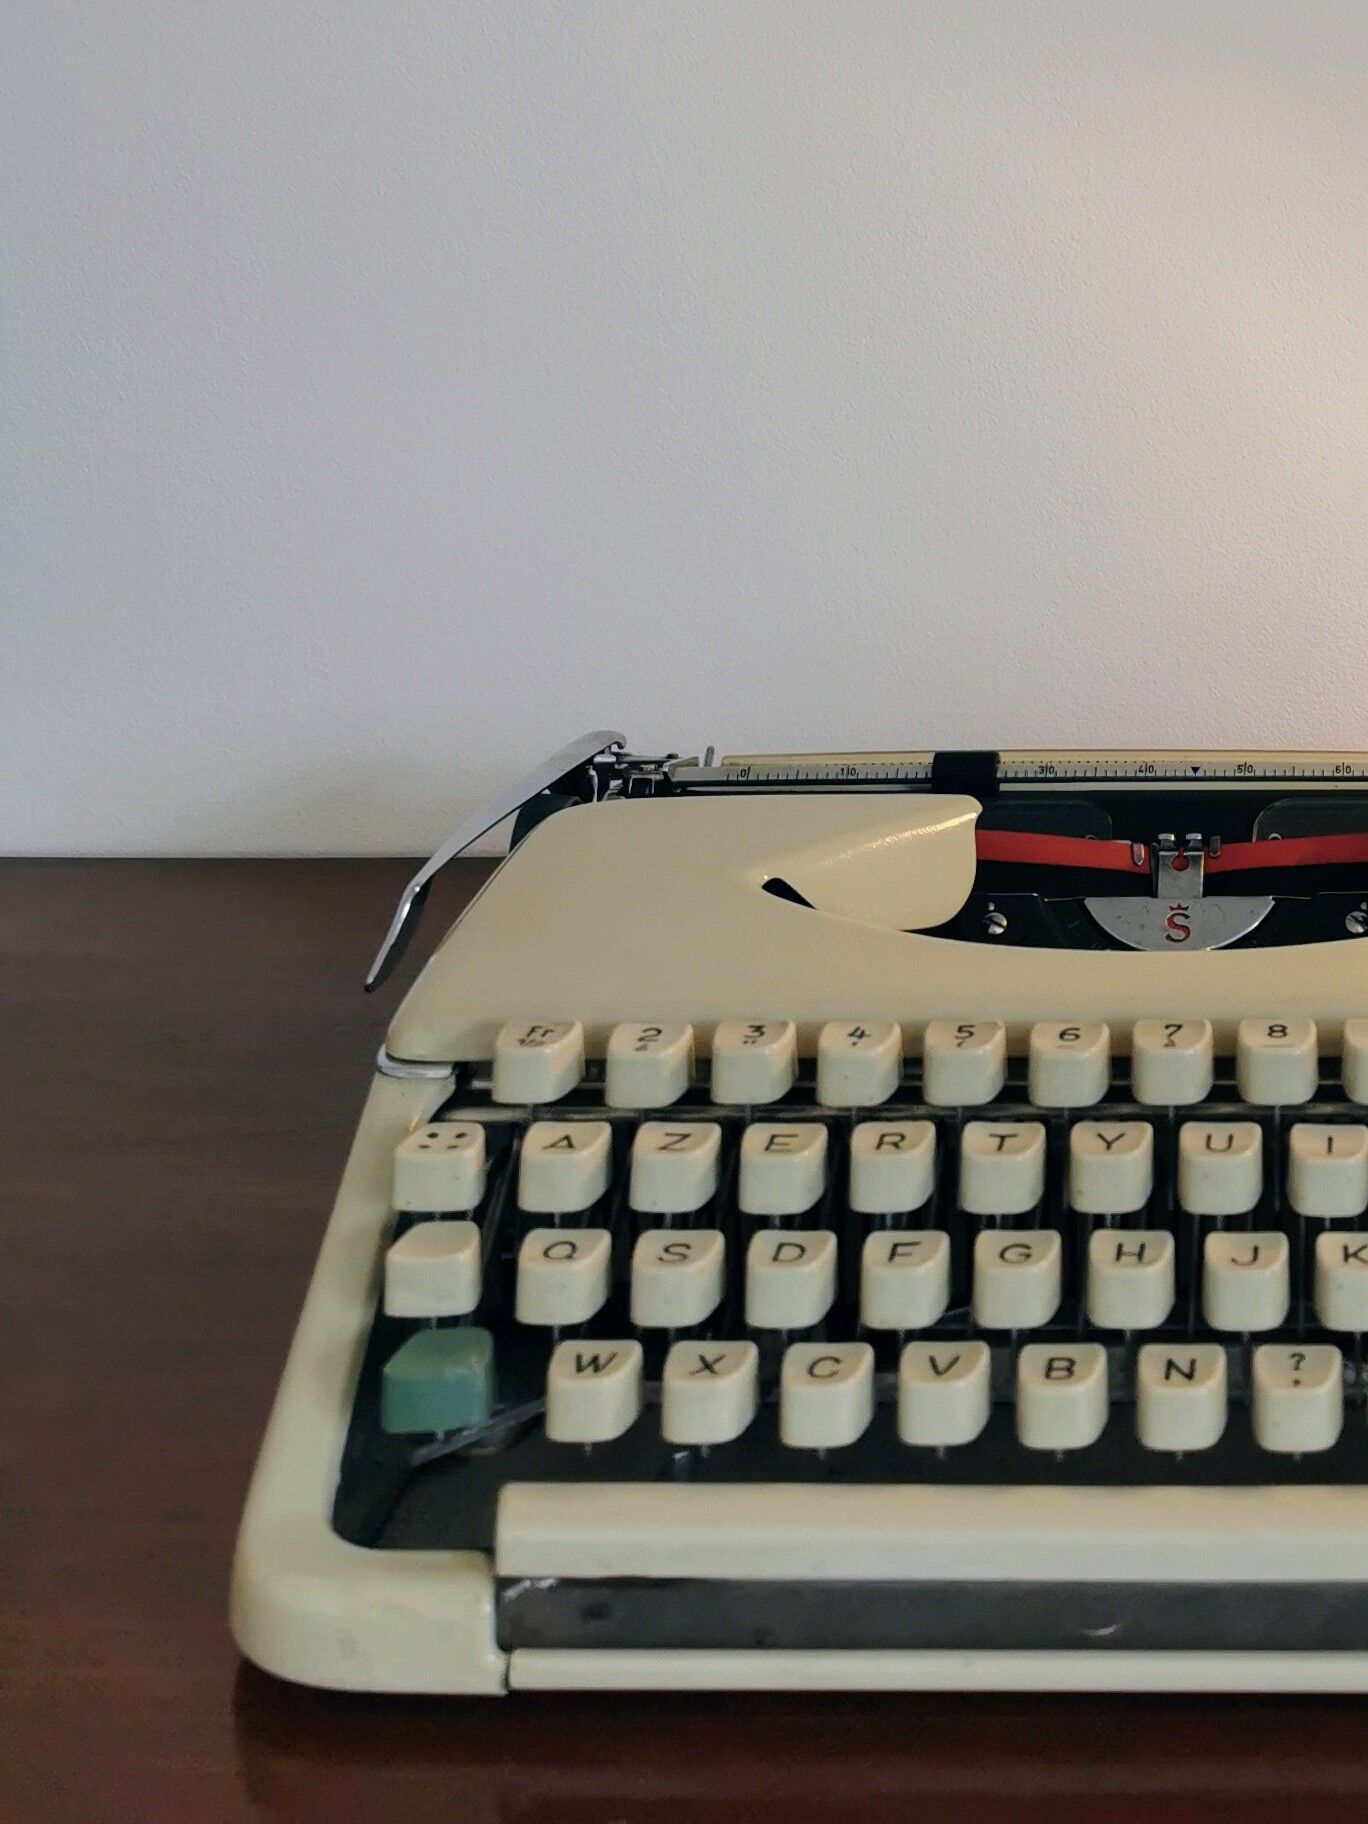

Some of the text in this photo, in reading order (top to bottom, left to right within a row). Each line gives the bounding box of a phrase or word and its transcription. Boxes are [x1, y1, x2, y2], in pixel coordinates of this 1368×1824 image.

[636, 1026, 663, 1042] 2
[743, 1024, 766, 1038] 3
[847, 1026, 872, 1040] 4
[955, 1024, 976, 1039] 5
[1058, 1027, 1081, 1042] 6
[1163, 1023, 1183, 1038] 7
[1266, 1024, 1289, 1039] 8
[541, 1133, 576, 1150] A
[656, 1132, 693, 1152] Z
[763, 1133, 800, 1153] E
[874, 1132, 907, 1152] R
[987, 1133, 1019, 1152] T
[1095, 1131, 1127, 1151] Y
[1204, 1132, 1234, 1152] U
[542, 1239, 578, 1263] Q
[657, 1241, 693, 1264] S
[771, 1241, 807, 1264] D
[886, 1240, 922, 1264] F
[998, 1242, 1034, 1265] G
[1113, 1241, 1148, 1264] H
[1230, 1244, 1261, 1267] J
[574, 1350, 619, 1376] W
[687, 1352, 729, 1377] X
[806, 1355, 844, 1379] C
[928, 1352, 961, 1377] V
[1043, 1356, 1079, 1382] B
[1163, 1357, 1198, 1382] N
